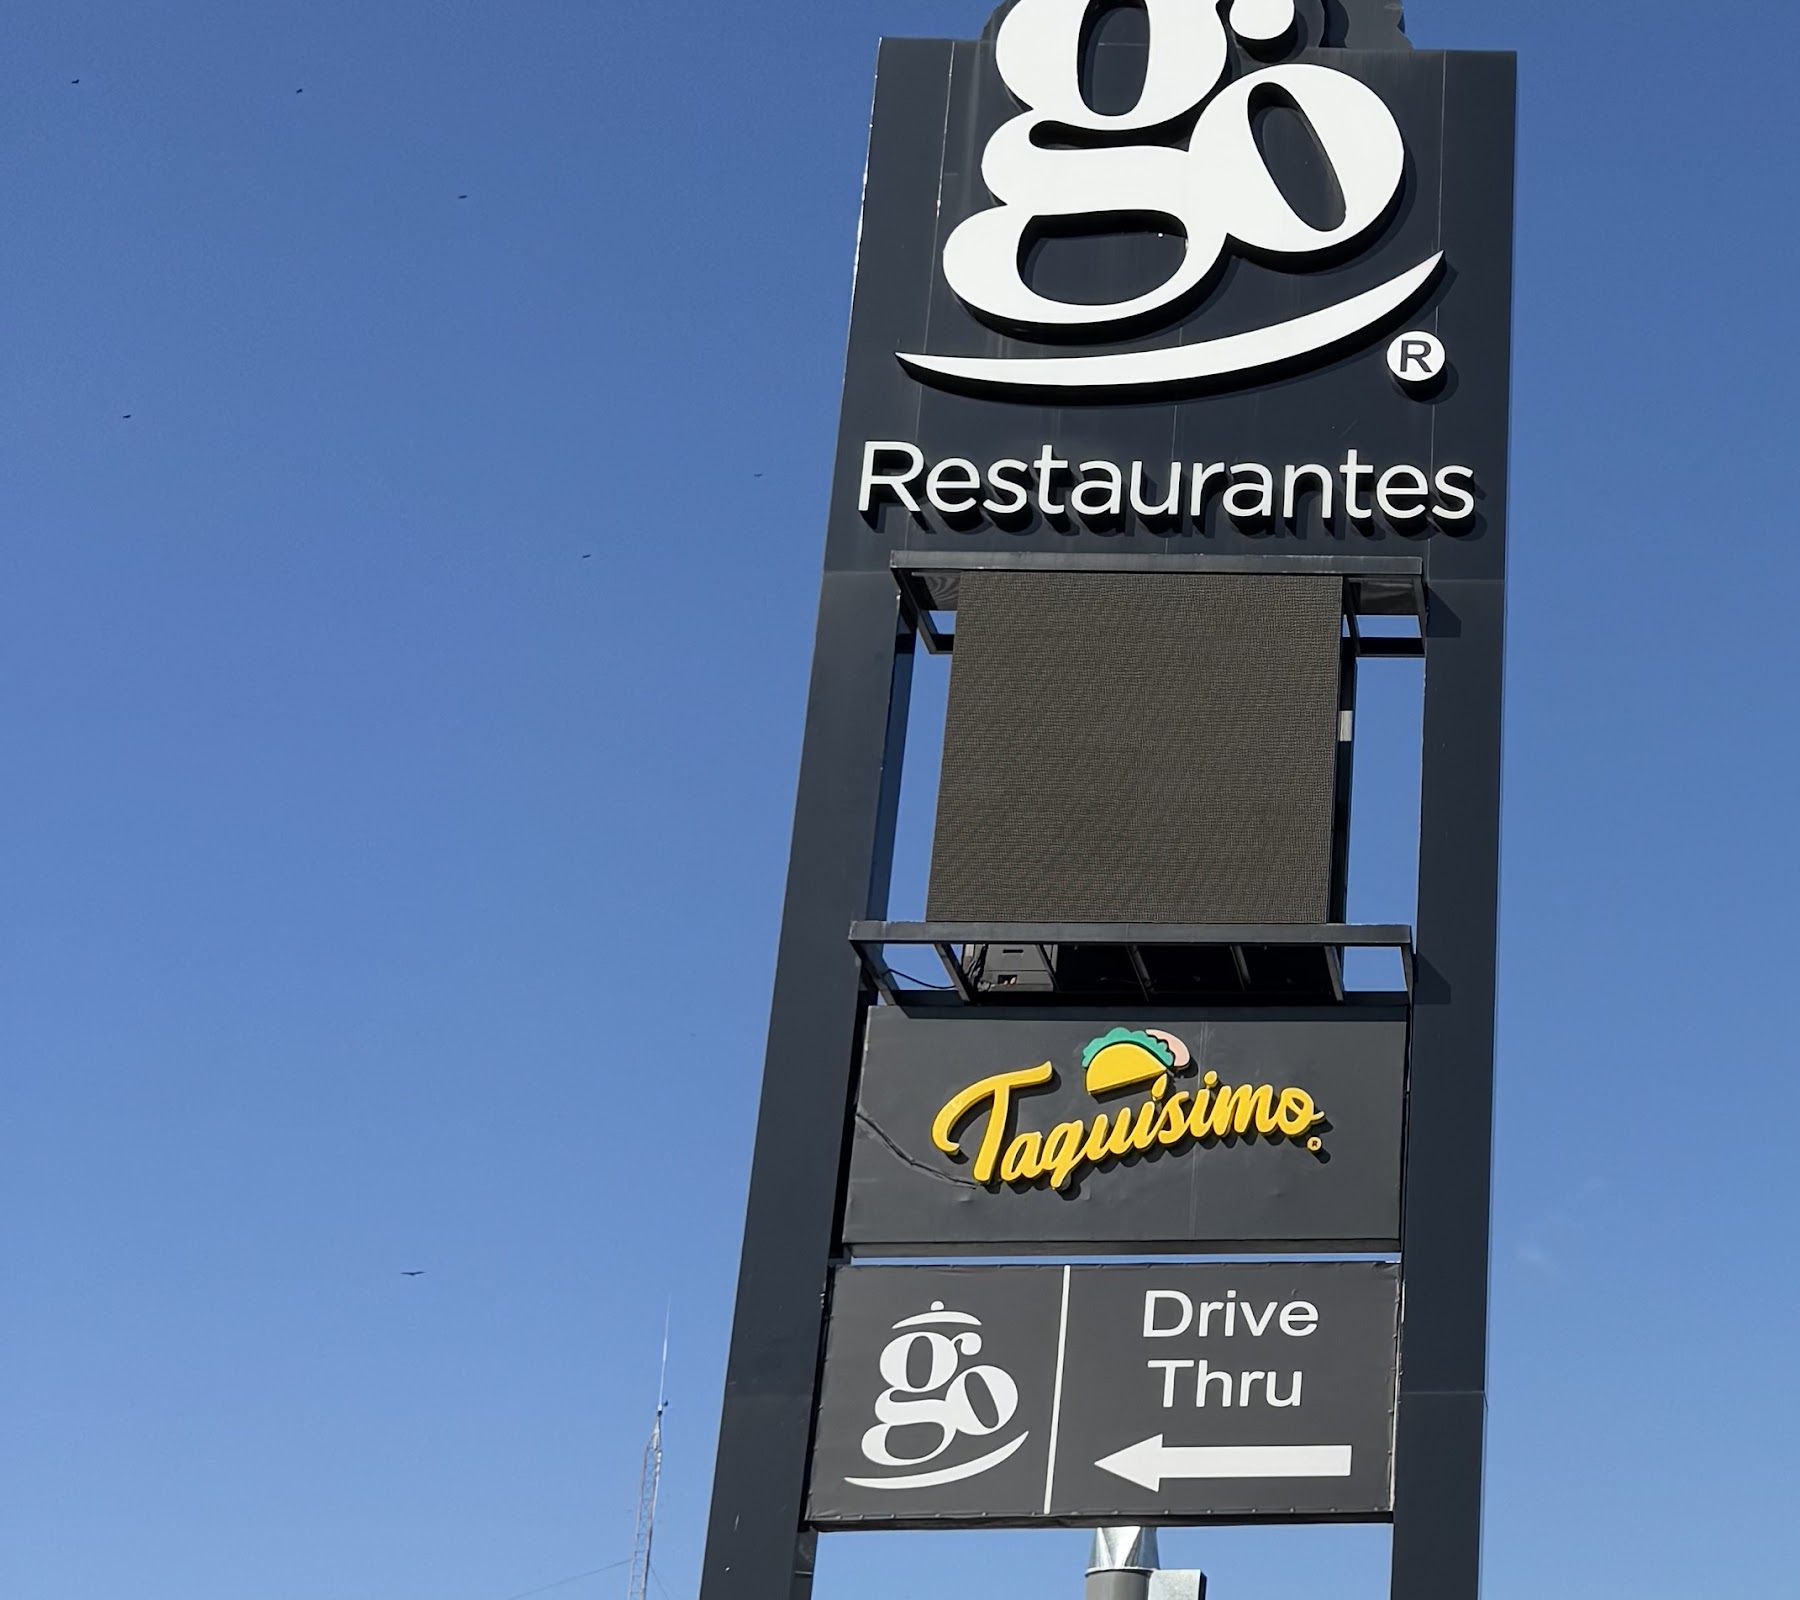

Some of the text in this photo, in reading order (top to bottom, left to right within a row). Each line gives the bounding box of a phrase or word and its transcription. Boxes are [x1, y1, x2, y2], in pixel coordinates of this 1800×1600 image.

[857, 440, 1475, 520] Restaurantes
[1142, 1289, 1320, 1339] Drive
[1147, 1359, 1303, 1408] Thru
